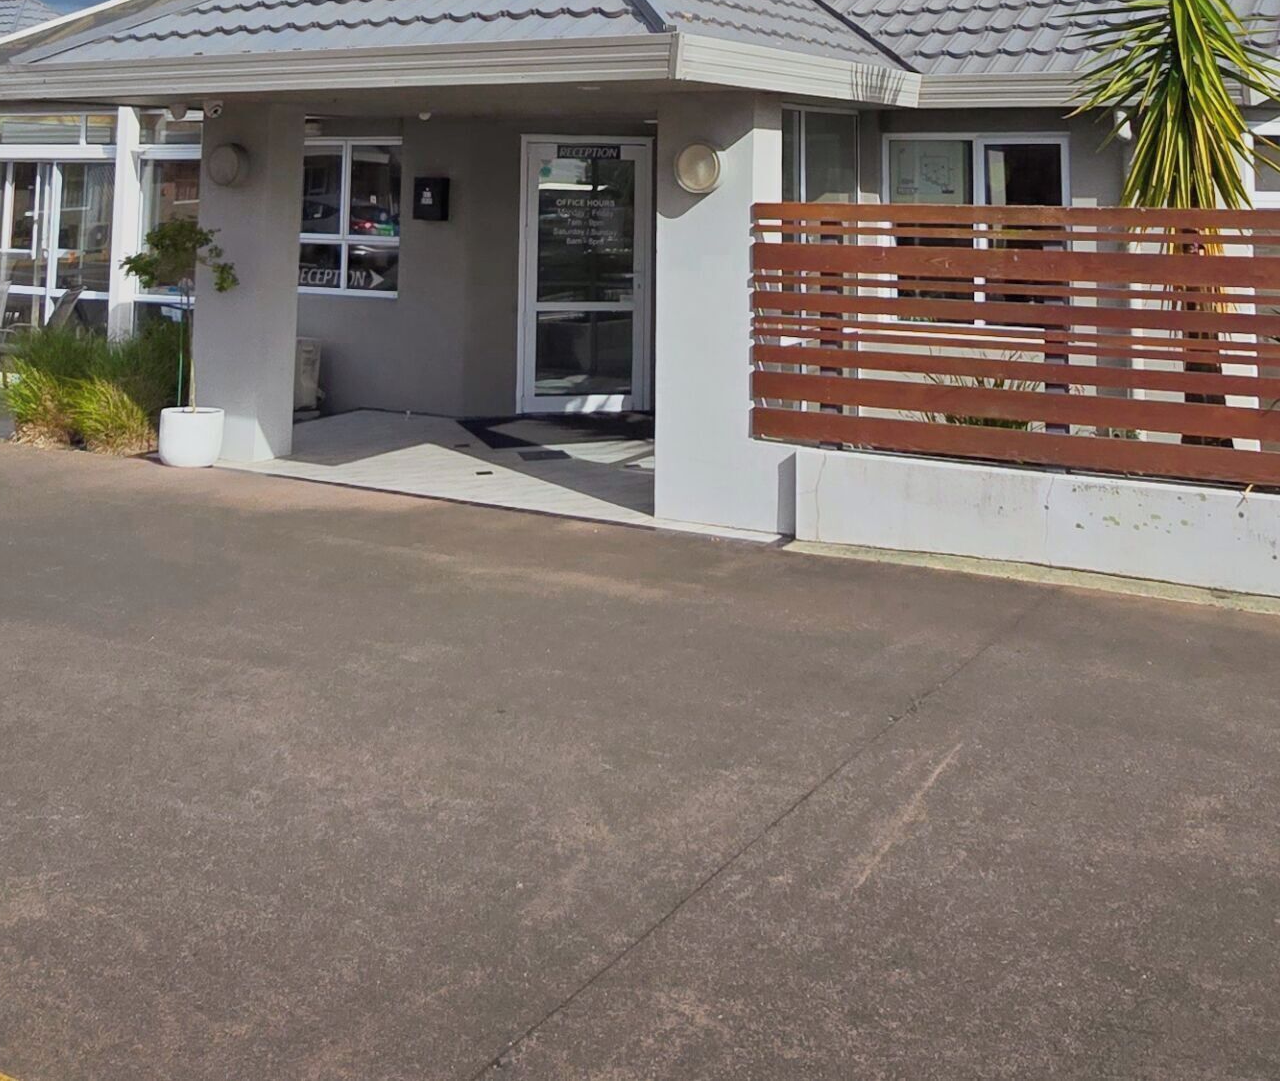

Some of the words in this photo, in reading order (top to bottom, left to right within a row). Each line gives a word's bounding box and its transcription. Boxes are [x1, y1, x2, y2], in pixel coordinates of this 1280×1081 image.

[560, 147, 618, 158] RECEPTION
[556, 199, 585, 207] OFFICE
[587, 199, 615, 207] HOURS
[299, 268, 367, 286] ECEPTON
